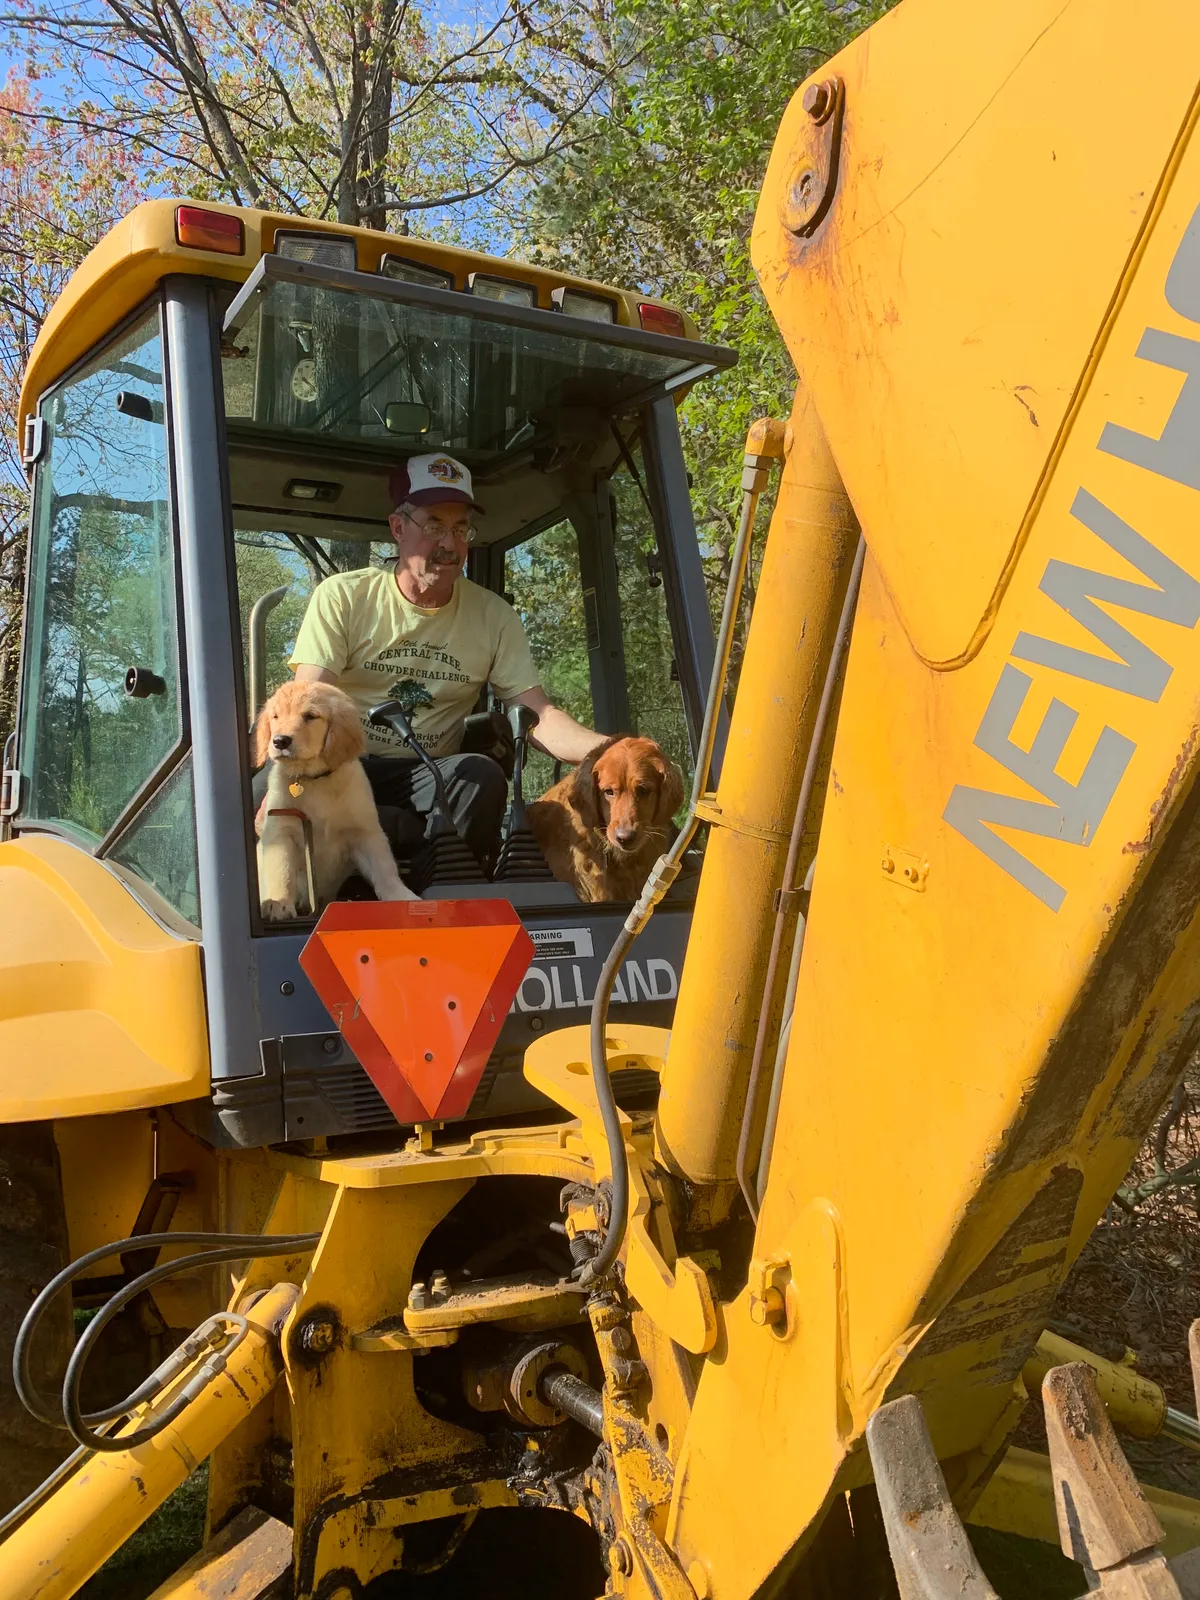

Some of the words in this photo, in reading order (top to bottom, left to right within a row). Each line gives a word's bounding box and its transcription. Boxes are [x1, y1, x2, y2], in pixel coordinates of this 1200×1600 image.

[398, 639, 418, 648] 10th
[378, 648, 431, 660] CENTRAL
[434, 651, 462, 671] TREE
[364, 661, 415, 676] CHOWDER
[415, 669, 471, 684] CHALLENGE
[941, 486, 1200, 913] NEW
[364, 729, 391, 745] gust
[530, 931, 564, 941] ARNING
[508, 958, 678, 1014] OLLAND
